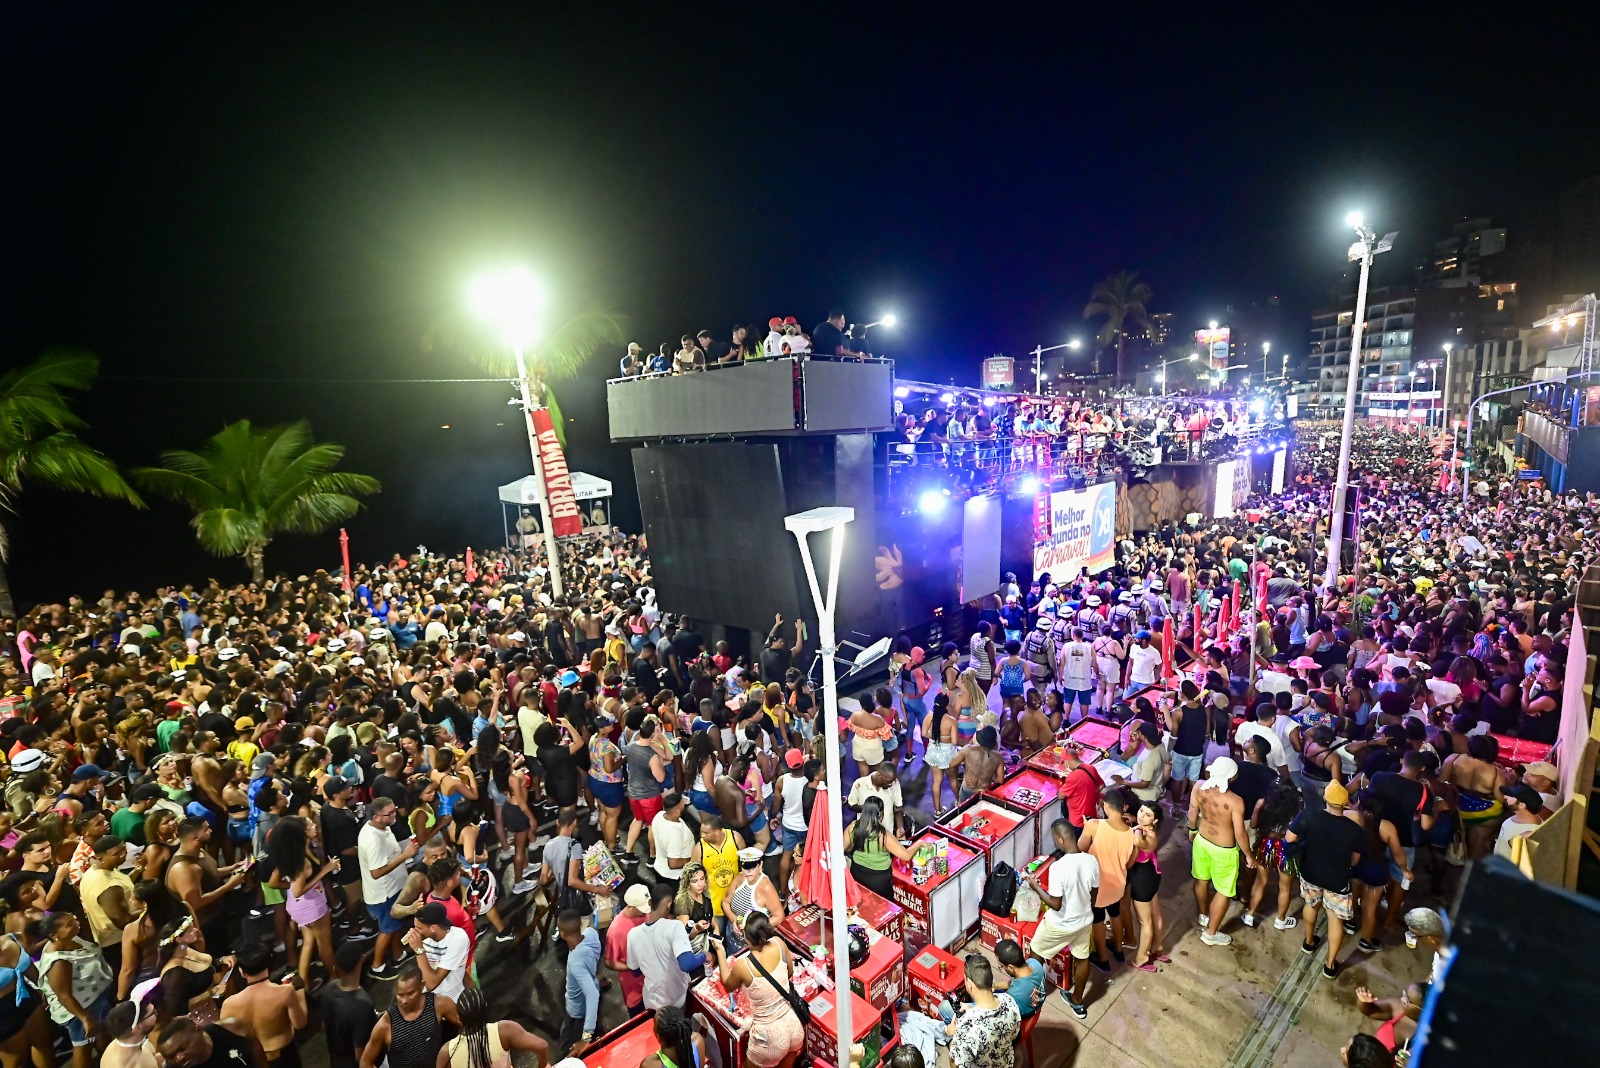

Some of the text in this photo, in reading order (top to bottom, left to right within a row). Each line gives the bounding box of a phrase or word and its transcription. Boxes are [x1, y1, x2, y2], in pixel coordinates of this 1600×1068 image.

[538, 428, 578, 519] BRAHMA
[1054, 507, 1085, 528] Melhor
[1080, 524, 1091, 538] no
[711, 859, 735, 870] TOWN
[799, 910, 821, 927] BRAHM
[800, 905, 818, 918] CARN
[890, 918, 899, 933] DE
